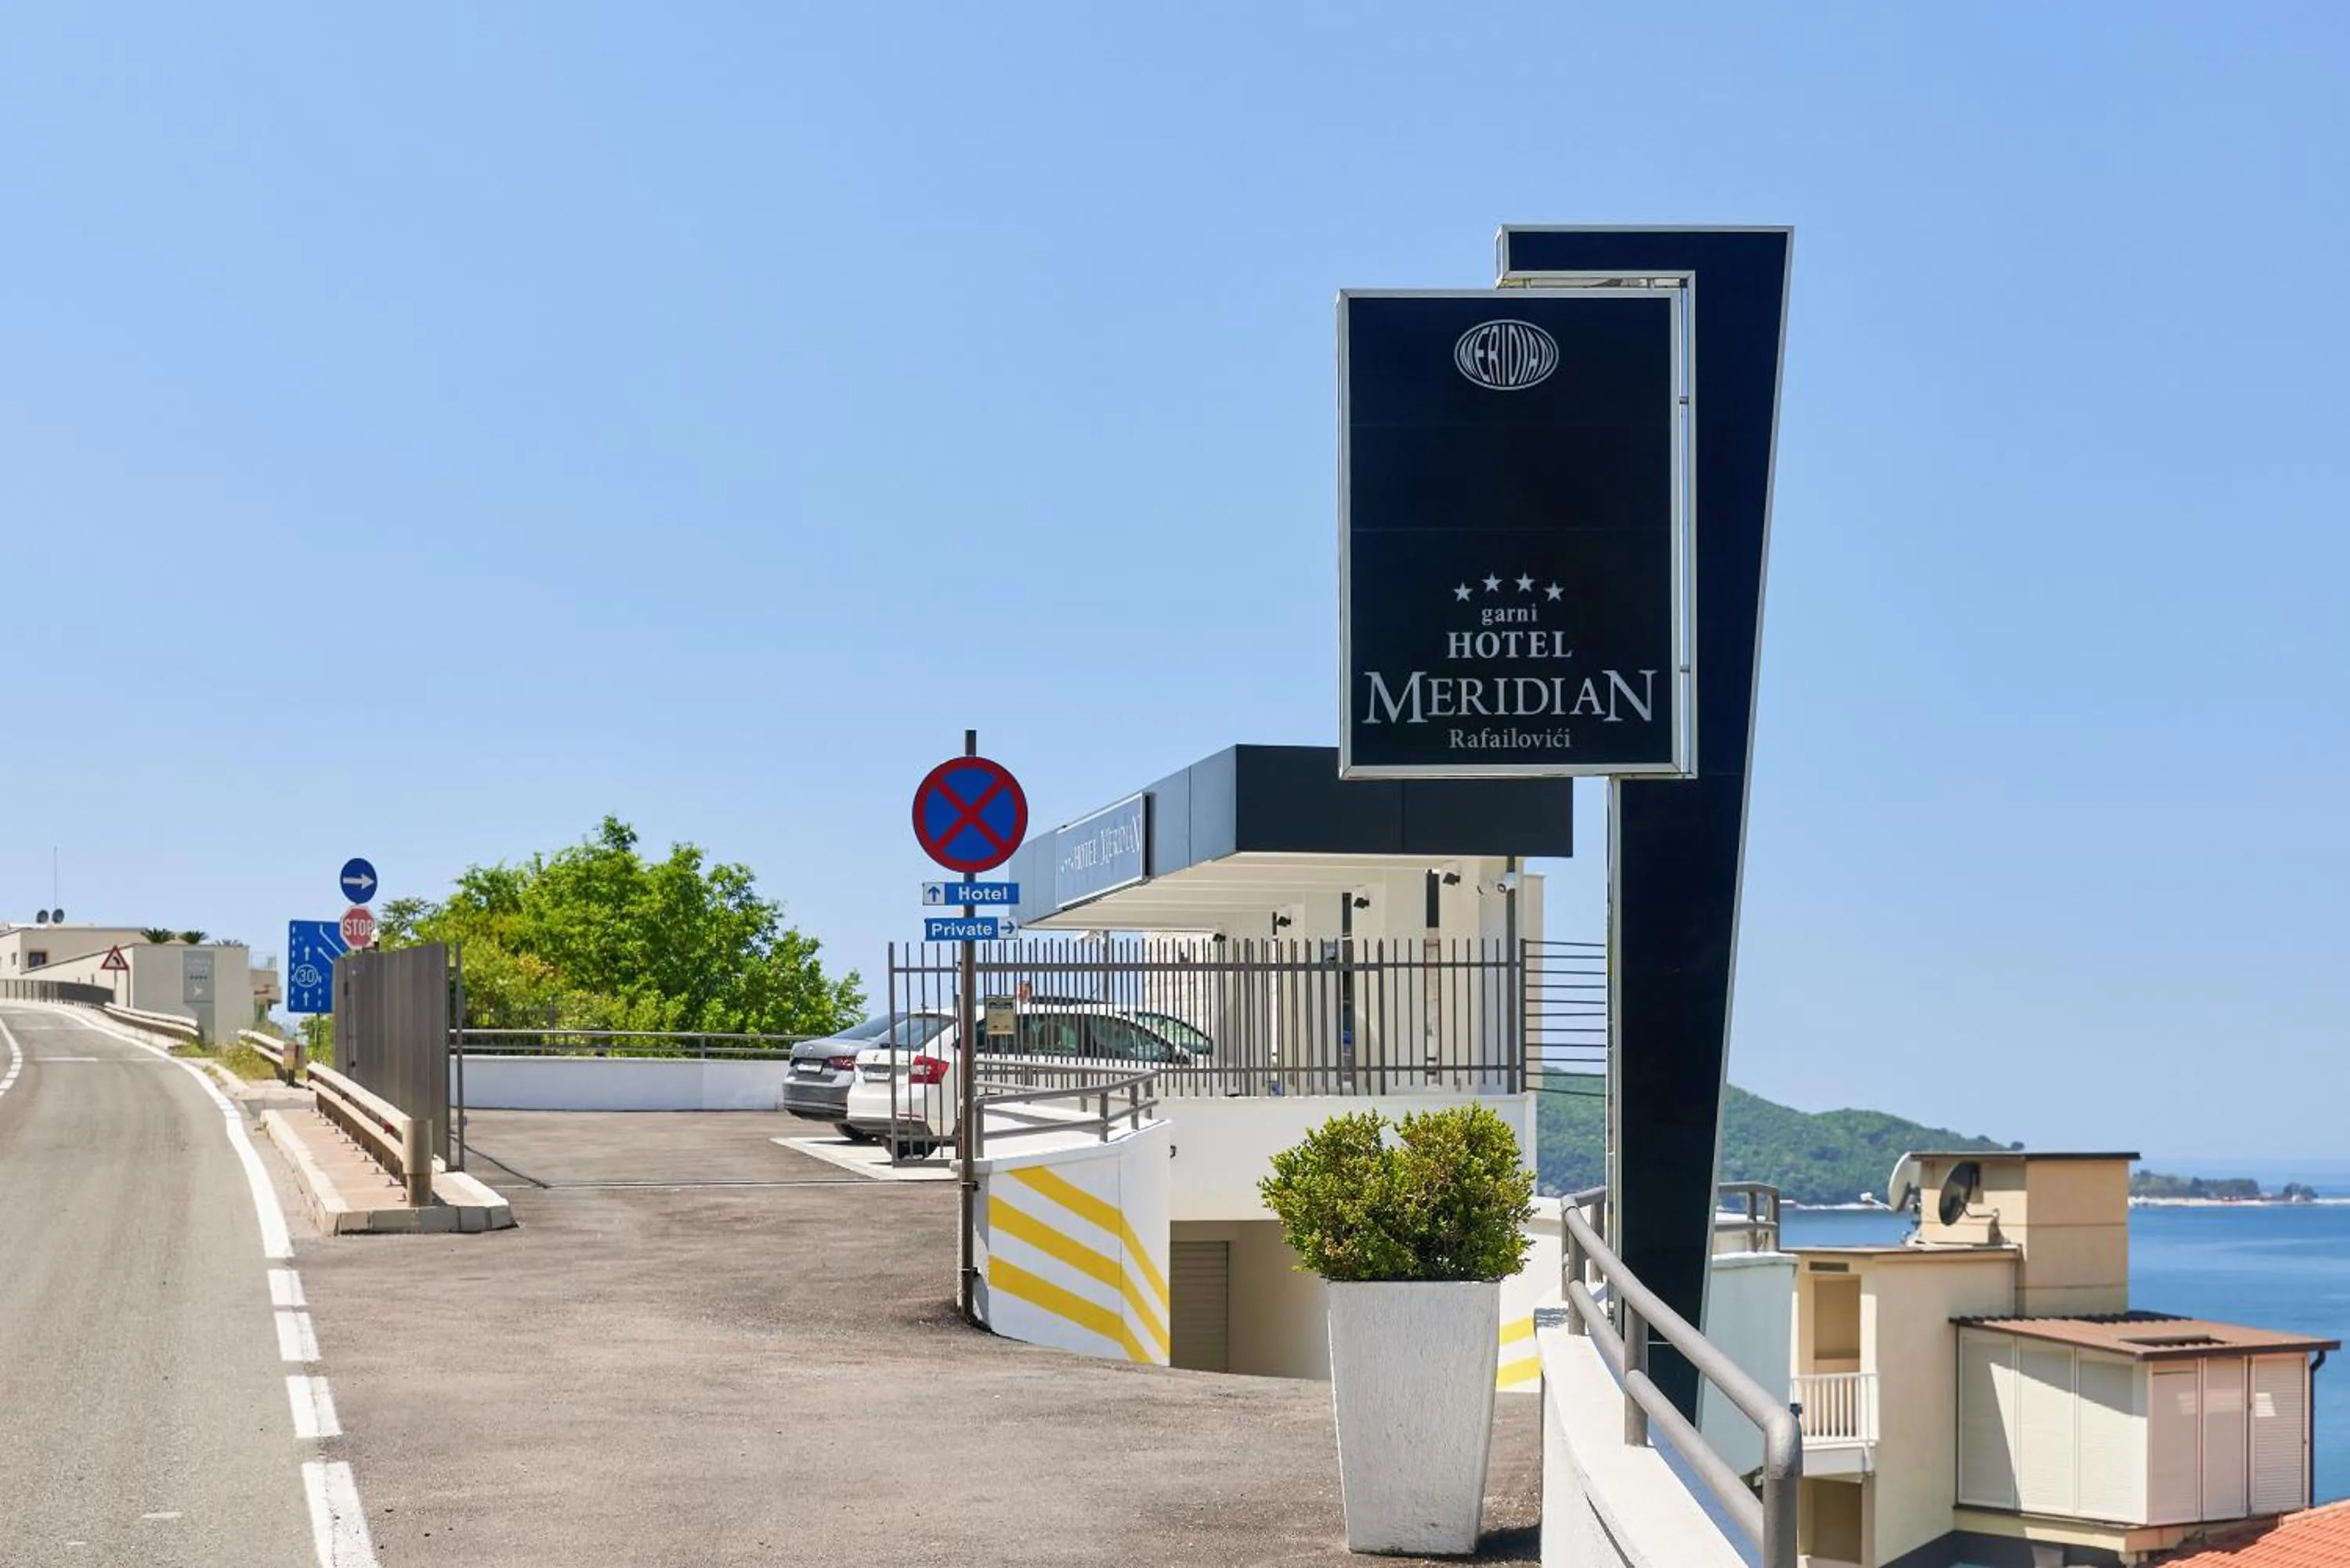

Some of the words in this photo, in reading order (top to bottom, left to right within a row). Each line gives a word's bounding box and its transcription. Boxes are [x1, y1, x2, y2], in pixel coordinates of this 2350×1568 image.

[1459, 323, 1554, 385] MERIDIAN
[1481, 604, 1538, 626] garni
[1447, 630, 1572, 659] HOTEL
[1361, 670, 1658, 724] MERIDIAN
[1448, 728, 1571, 750] Rafailovići
[1074, 839, 1097, 870] HOTEL
[958, 886, 1008, 901] Hotel
[344, 919, 374, 937] STOP
[931, 923, 993, 938] Private
[298, 969, 314, 983] 30
